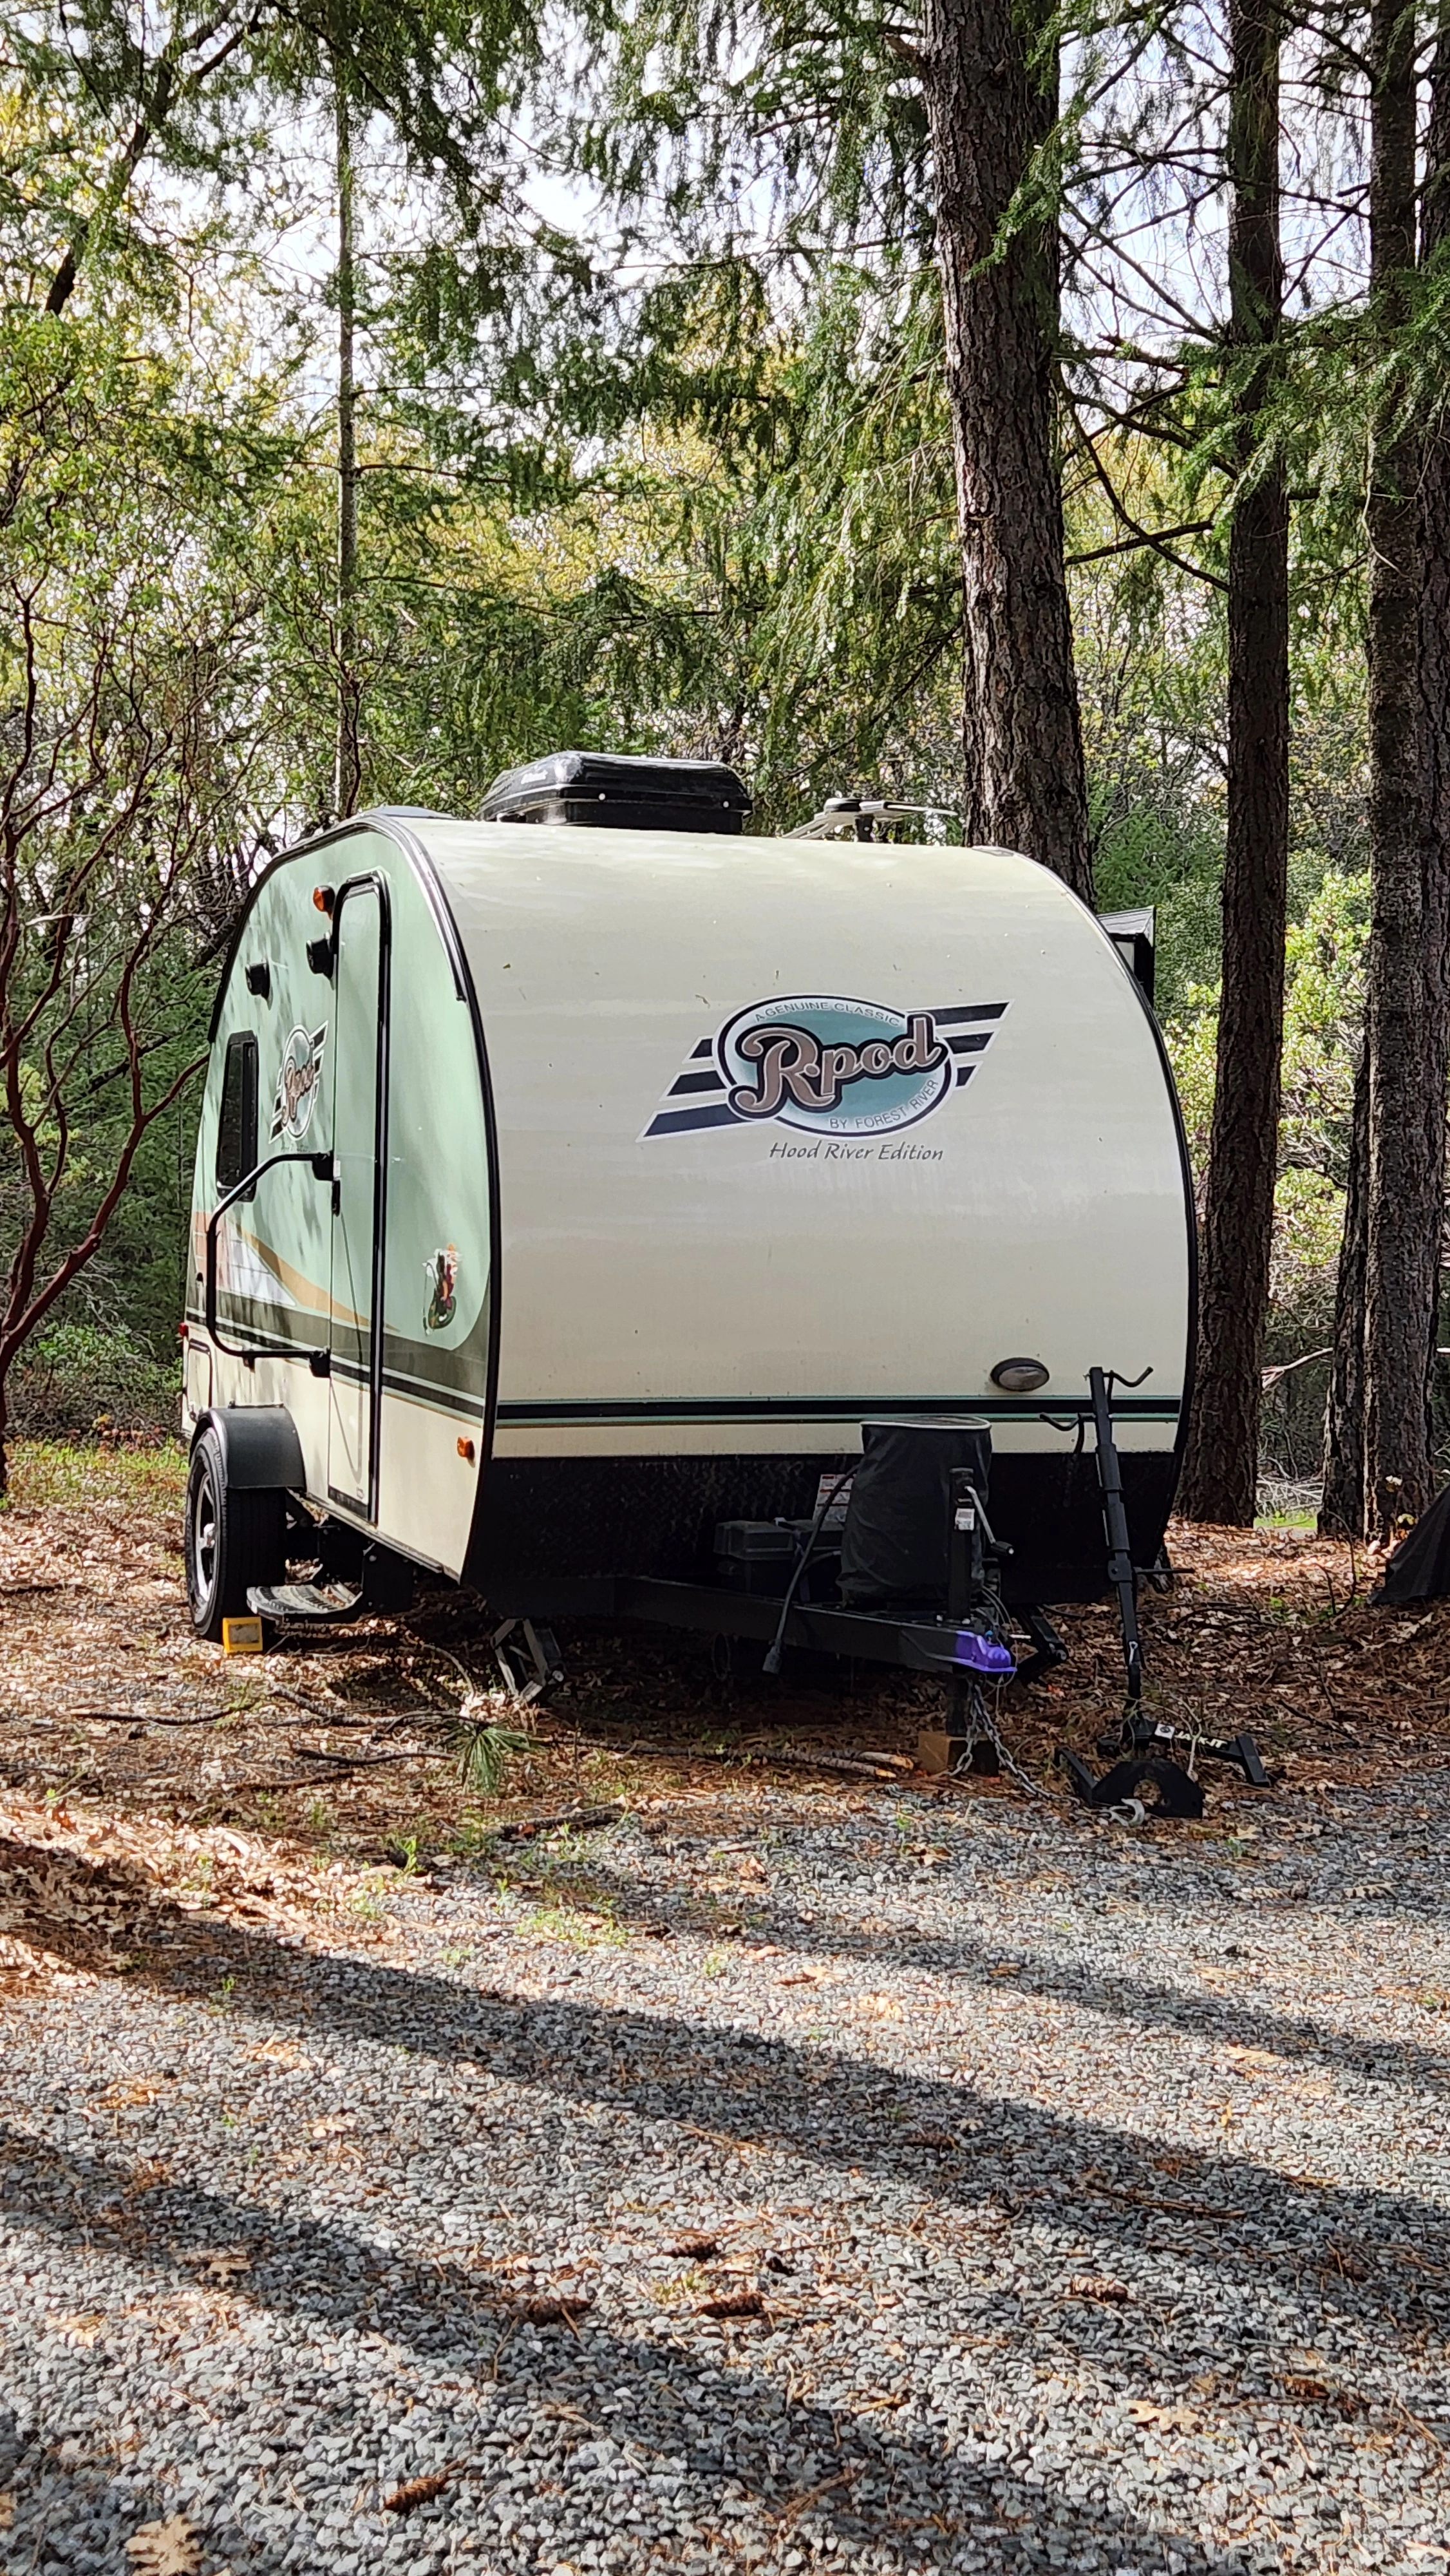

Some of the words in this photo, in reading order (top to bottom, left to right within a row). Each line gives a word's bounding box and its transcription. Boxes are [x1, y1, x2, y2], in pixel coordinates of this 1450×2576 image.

[755, 1013, 766, 1022] A
[765, 1001, 830, 1018] GENUINE
[834, 1002, 900, 1027] CLASSIC
[829, 1117, 848, 1130] BY
[855, 1105, 908, 1129] FOREST
[909, 1079, 939, 1110] RIVER
[769, 1139, 822, 1158] Hood
[824, 1142, 874, 1160] River
[878, 1141, 944, 1161] Edition
[1174, 1730, 1228, 1748] JAK-IT
